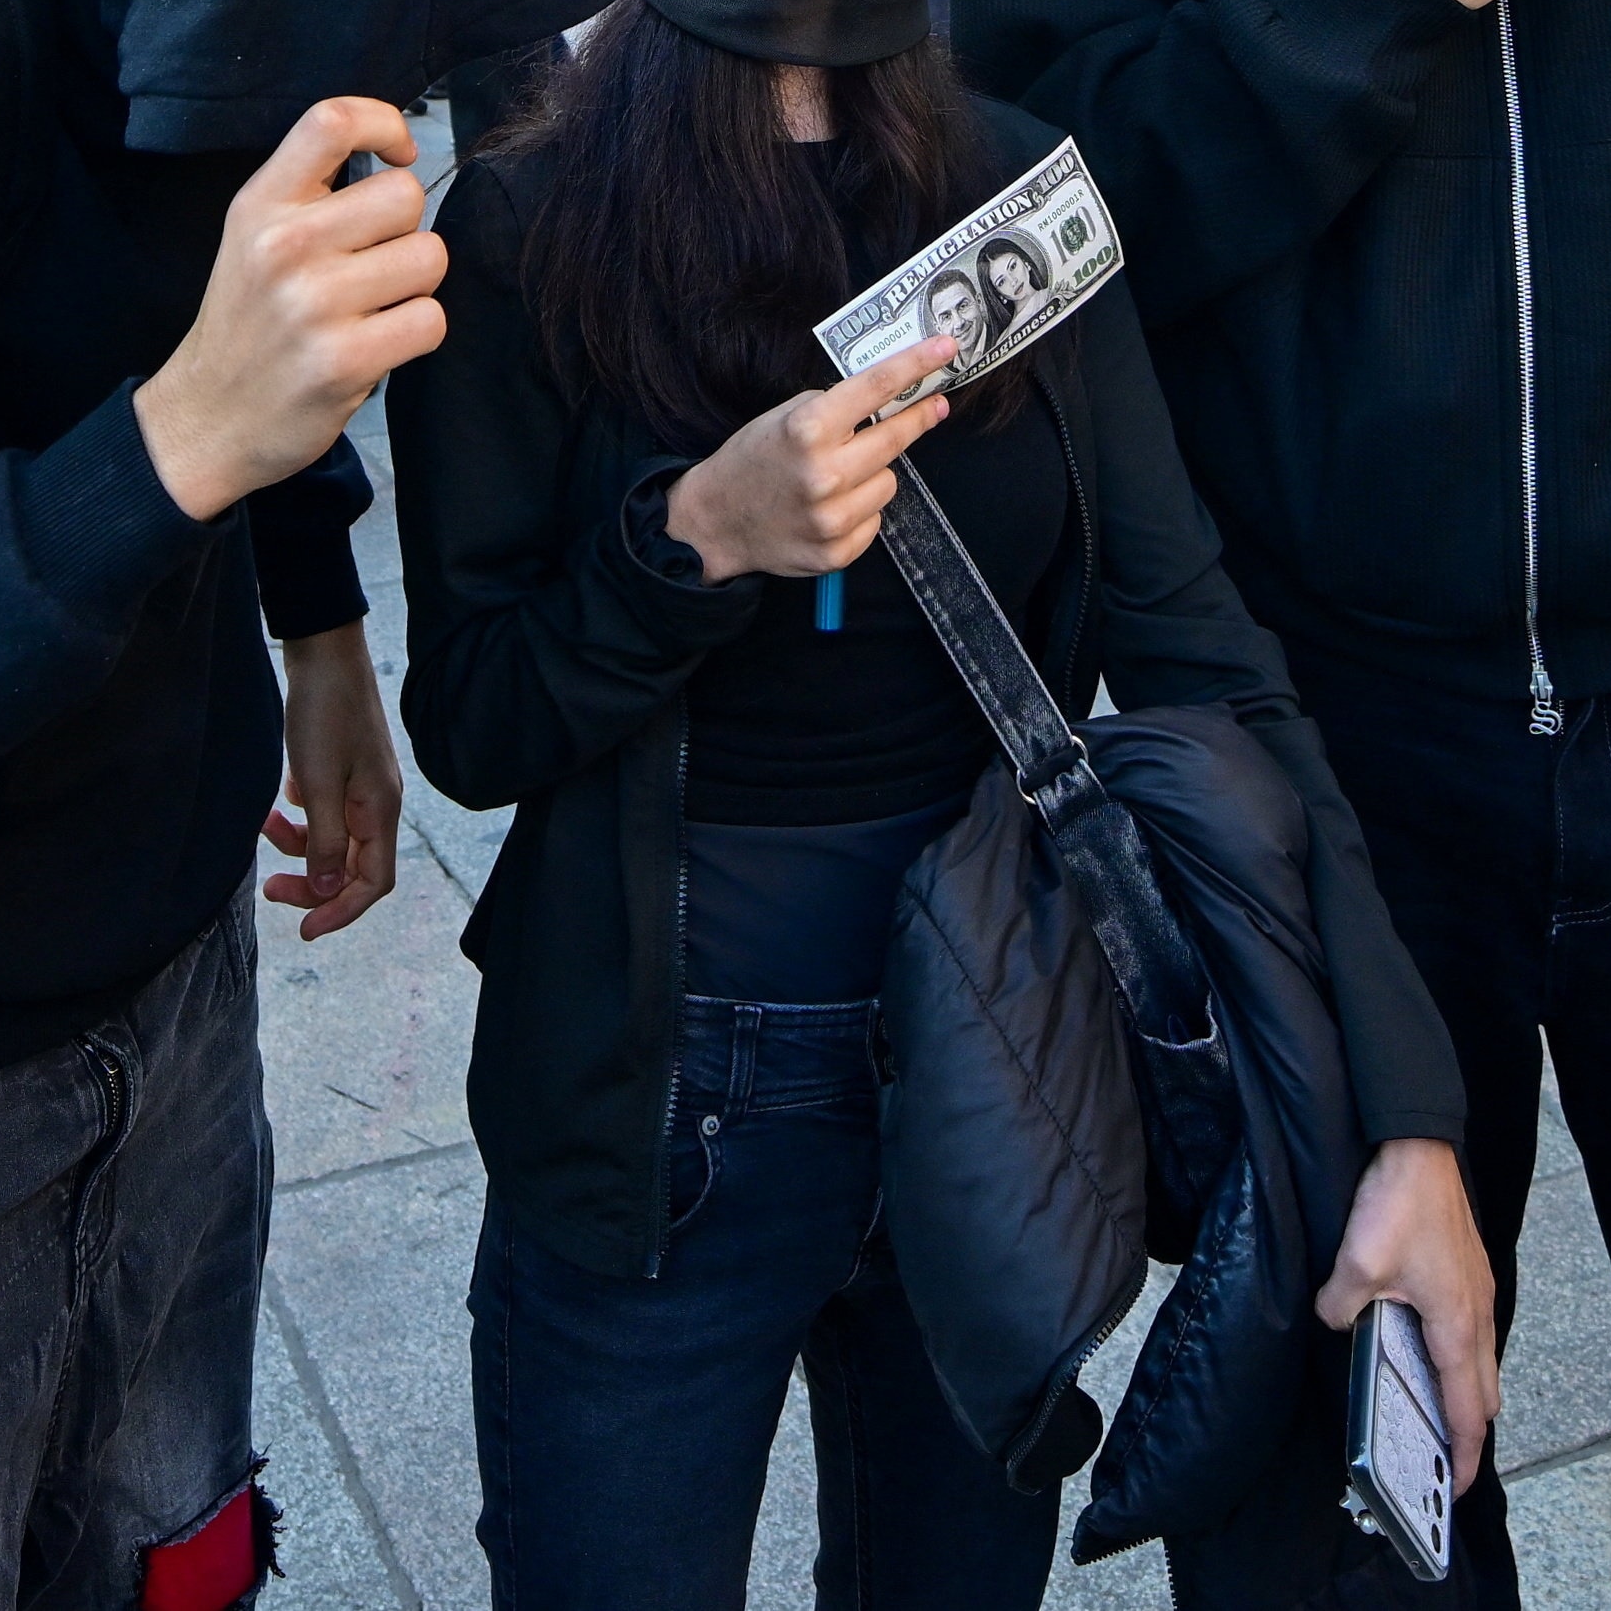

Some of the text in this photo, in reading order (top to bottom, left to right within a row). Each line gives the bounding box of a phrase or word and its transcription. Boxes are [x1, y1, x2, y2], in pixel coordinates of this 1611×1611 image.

[1037, 188, 1085, 232] RM1000001R
[829, 152, 1075, 349] 100 REMIGRATION 100
[1071, 245, 1114, 288] 100
[856, 321, 913, 367] RM1000001R
